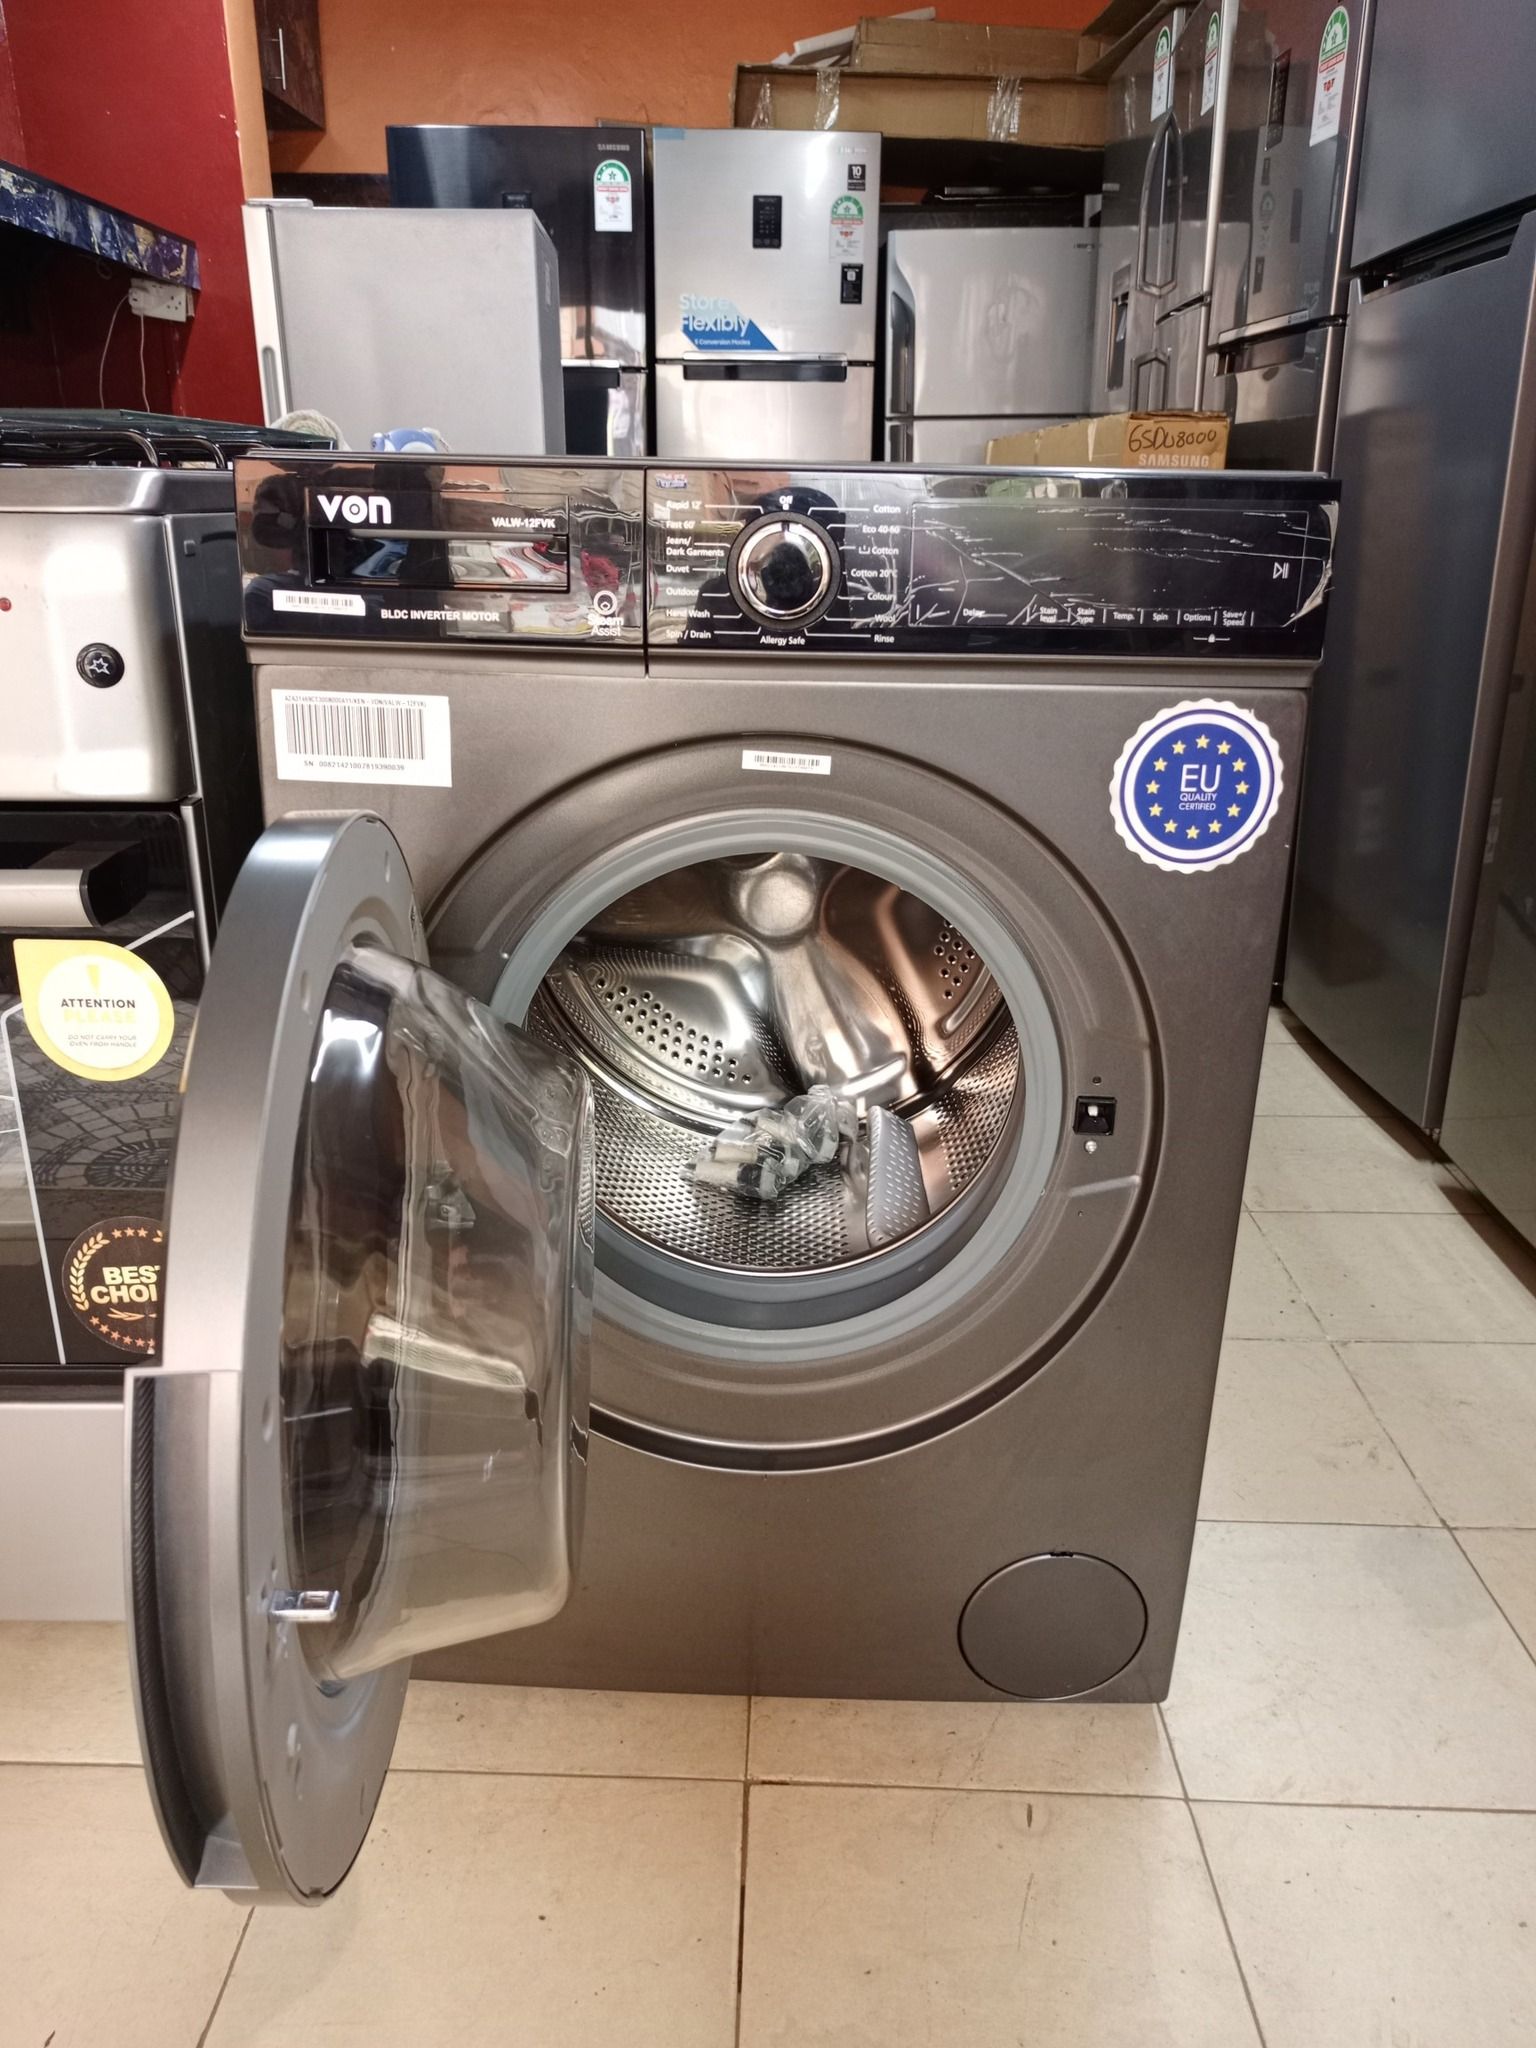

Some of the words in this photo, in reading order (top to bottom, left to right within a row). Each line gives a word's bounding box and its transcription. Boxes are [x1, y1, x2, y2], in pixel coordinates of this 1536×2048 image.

[680, 294, 729, 310] Store
[682, 315, 750, 337] Flexibly
[1138, 454, 1209, 467] SAMSUNG
[779, 495, 793, 505] Off
[666, 501, 689, 511] Rapid
[873, 505, 900, 513] Cotton
[491, 517, 556, 528] VALW-12FVK
[666, 521, 682, 529] Fast
[862, 525, 876, 534] Eco
[878, 525, 900, 534] 40-60
[666, 536, 692, 546] Jeans/
[666, 548, 685, 556] Dark
[686, 548, 725, 557] Garments
[871, 546, 899, 555] Cotton
[666, 564, 690, 573] Duvet
[851, 569, 878, 578] Cotton
[666, 587, 699, 596] Outdoor
[666, 609, 687, 618] Hand
[688, 609, 711, 618] Wash
[1040, 606, 1058, 614] Stain
[1077, 607, 1096, 616] Stain
[380, 609, 409, 619] BLDC
[410, 609, 460, 620] INVERTER
[462, 611, 500, 622] MOTOR
[587, 613, 624, 627] Steam
[874, 614, 896, 622] Wool
[1113, 611, 1135, 621] Temp.
[1152, 613, 1169, 621] Spin
[1183, 614, 1212, 623] Options
[1222, 618, 1245, 627] Speed
[591, 627, 621, 637] Assist
[666, 630, 682, 640] Spin
[690, 630, 711, 639] Drain
[760, 635, 787, 646] Allergy
[788, 636, 806, 645] Safe
[874, 634, 895, 643] Rinse
[1180, 764, 1221, 793] EU
[1180, 793, 1217, 802] QUALITY
[1179, 803, 1216, 811] CERTIFIED
[61, 998, 136, 1009] ATTENTION
[63, 1010, 136, 1024] PLEASE
[90, 1284, 158, 1304] CHOI
